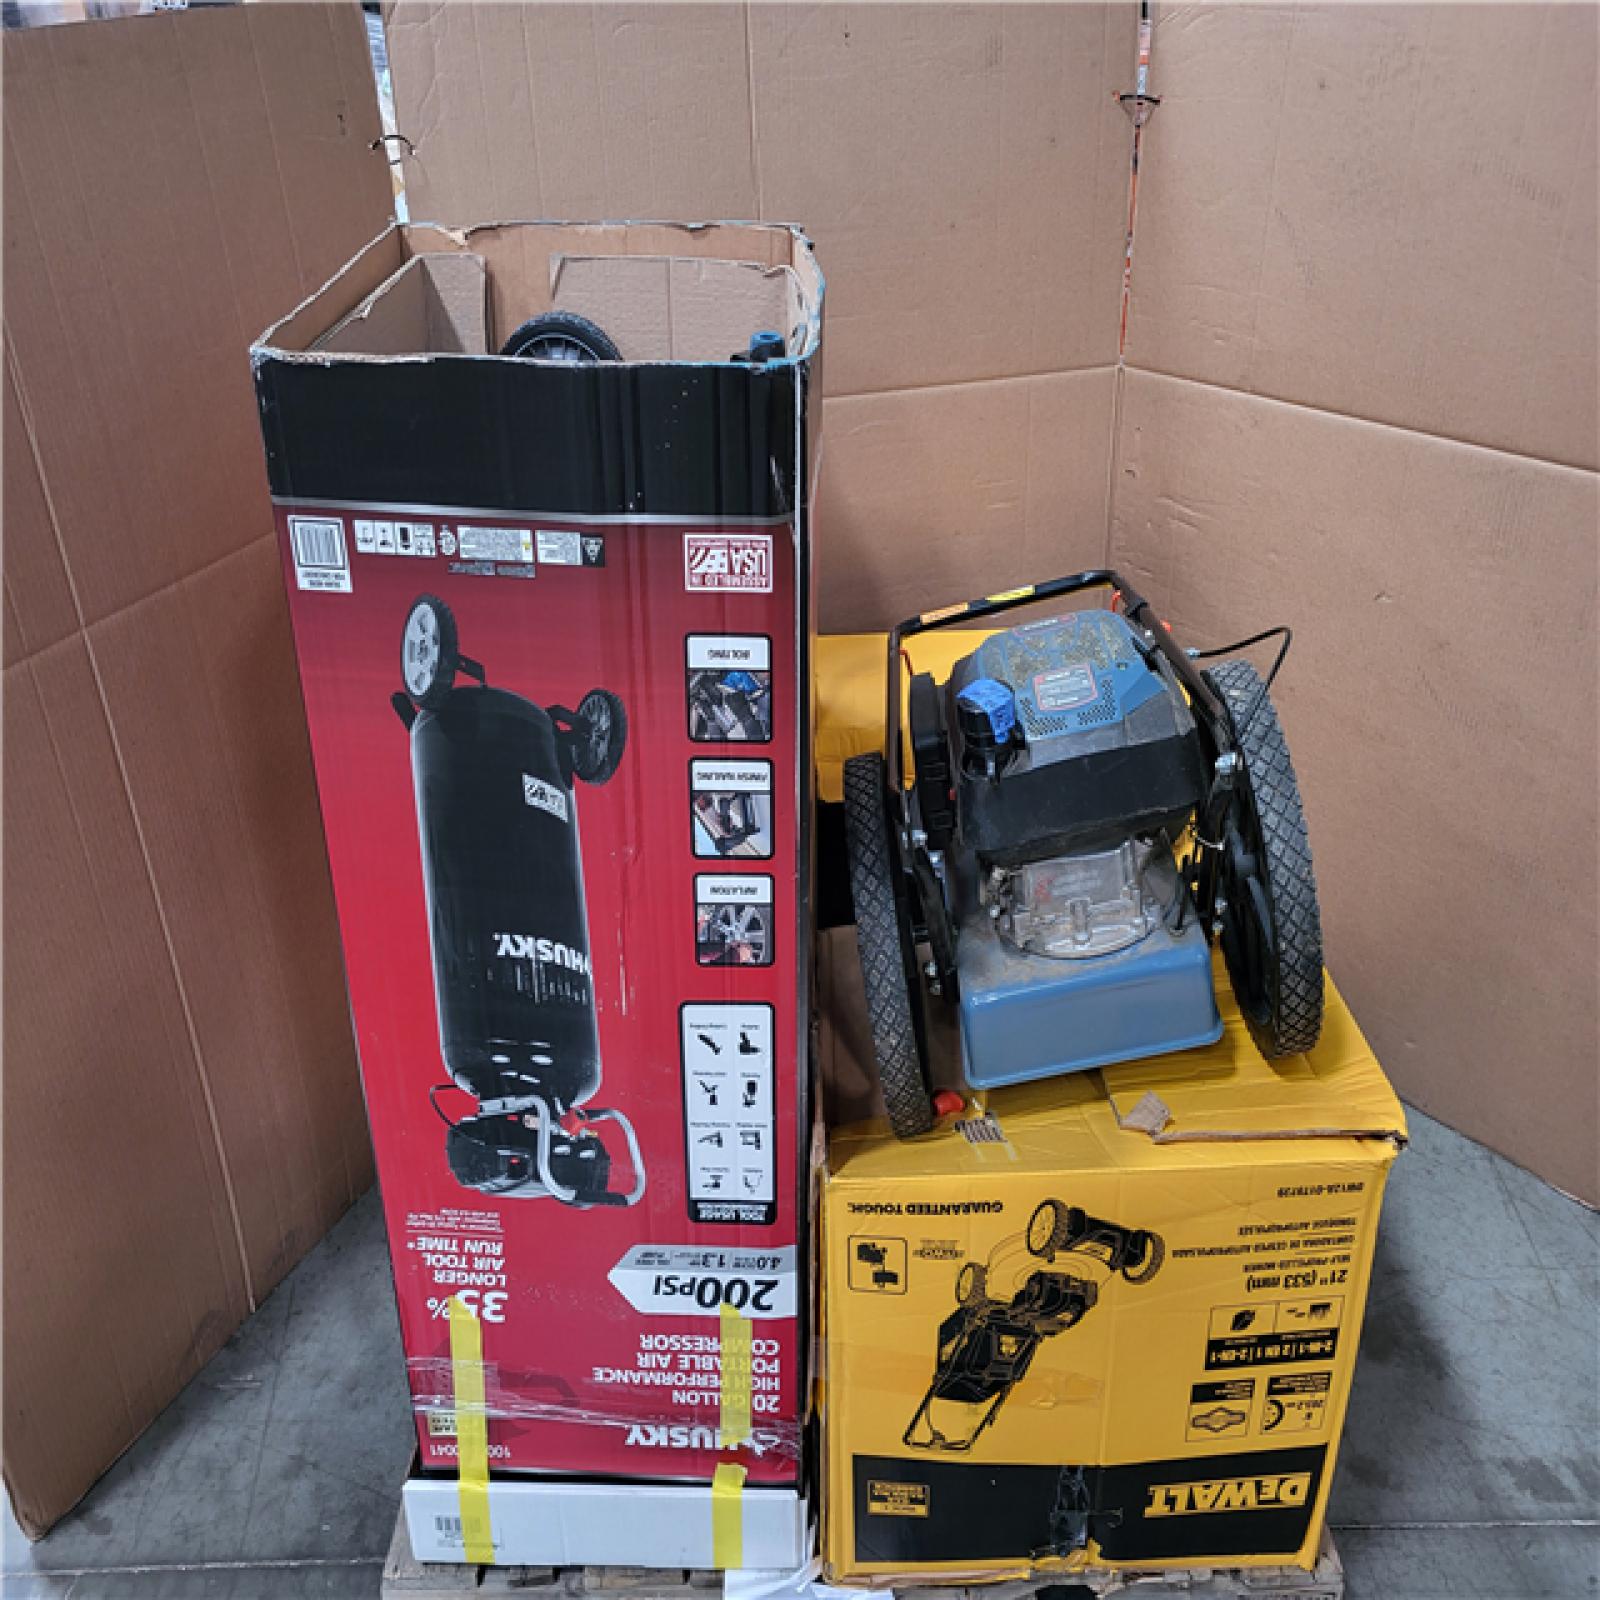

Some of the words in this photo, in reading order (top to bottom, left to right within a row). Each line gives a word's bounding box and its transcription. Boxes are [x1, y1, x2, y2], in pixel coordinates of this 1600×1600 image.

[730, 547, 767, 576] USA
[706, 648, 751, 661] BOLTING
[697, 772, 736, 782] NAILING
[737, 773, 768, 784] FINISH
[709, 885, 759, 897] INFLATION
[906, 1201, 1003, 1216] GUARANTEED
[464, 1240, 503, 1256] RUN
[1290, 1240, 1301, 1249] DE
[421, 1252, 468, 1269] TOOL
[474, 1256, 505, 1271] AIR
[433, 1269, 506, 1288] LONGER
[635, 1352, 671, 1369] AIR
[752, 1393, 781, 1412] 20
